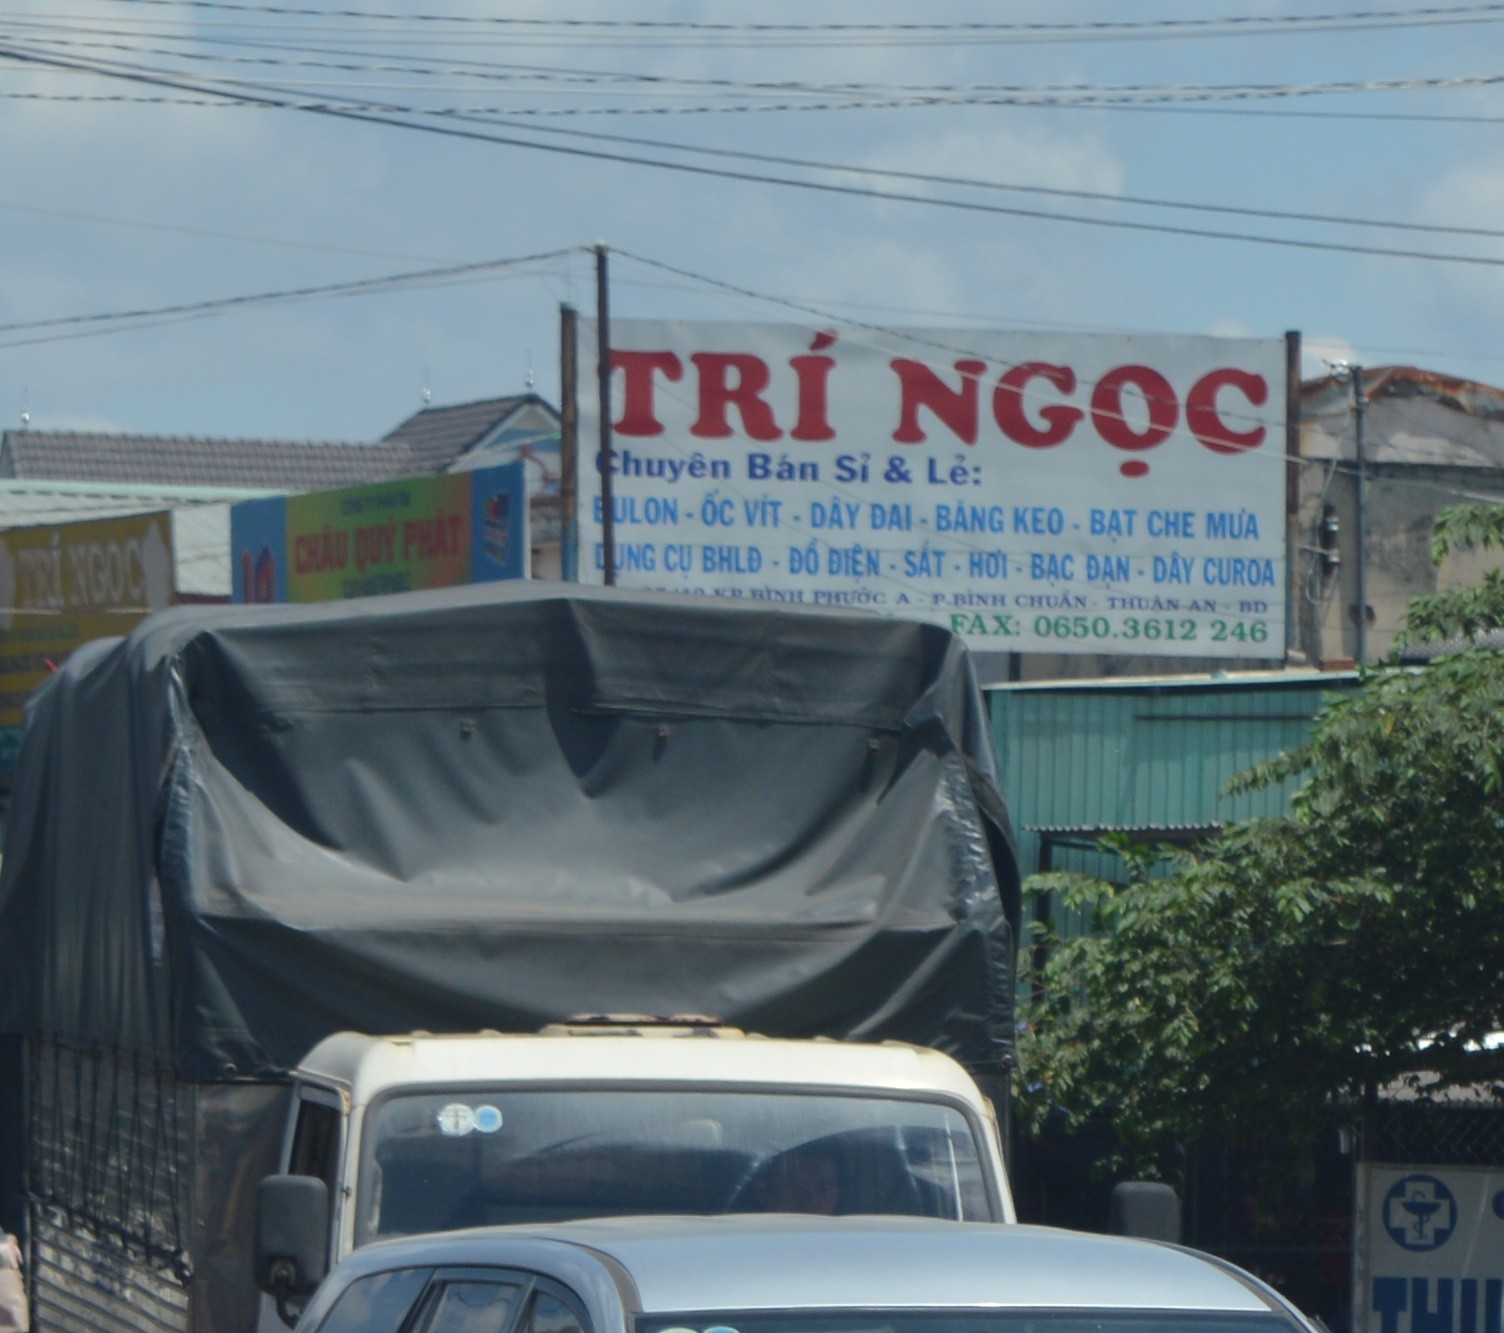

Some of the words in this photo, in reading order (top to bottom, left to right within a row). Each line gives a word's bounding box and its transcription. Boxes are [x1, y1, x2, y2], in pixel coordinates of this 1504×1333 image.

[602, 330, 838, 442] TRÍ
[889, 358, 1269, 478] NGỌC
[747, 451, 821, 483] Bán
[834, 453, 872, 483] Sỉ
[883, 455, 914, 484] &
[701, 489, 736, 527] ỐC
[811, 496, 861, 531] DÂY
[936, 497, 1004, 533] BĂNG
[1013, 507, 1065, 534] KEO
[1090, 509, 1138, 544] BẠT
[1147, 511, 1196, 539] CHE
[1206, 507, 1260, 541] MƯA
[702, 545, 764, 574] BHLĐ
[828, 543, 881, 583] ĐIỆN
[1152, 551, 1195, 584] DÂY
[1202, 558, 1276, 586] CUROA
[950, 613, 1021, 637] FAX:
[1034, 614, 1198, 641] 0650.3612
[1211, 618, 1269, 643] 246
